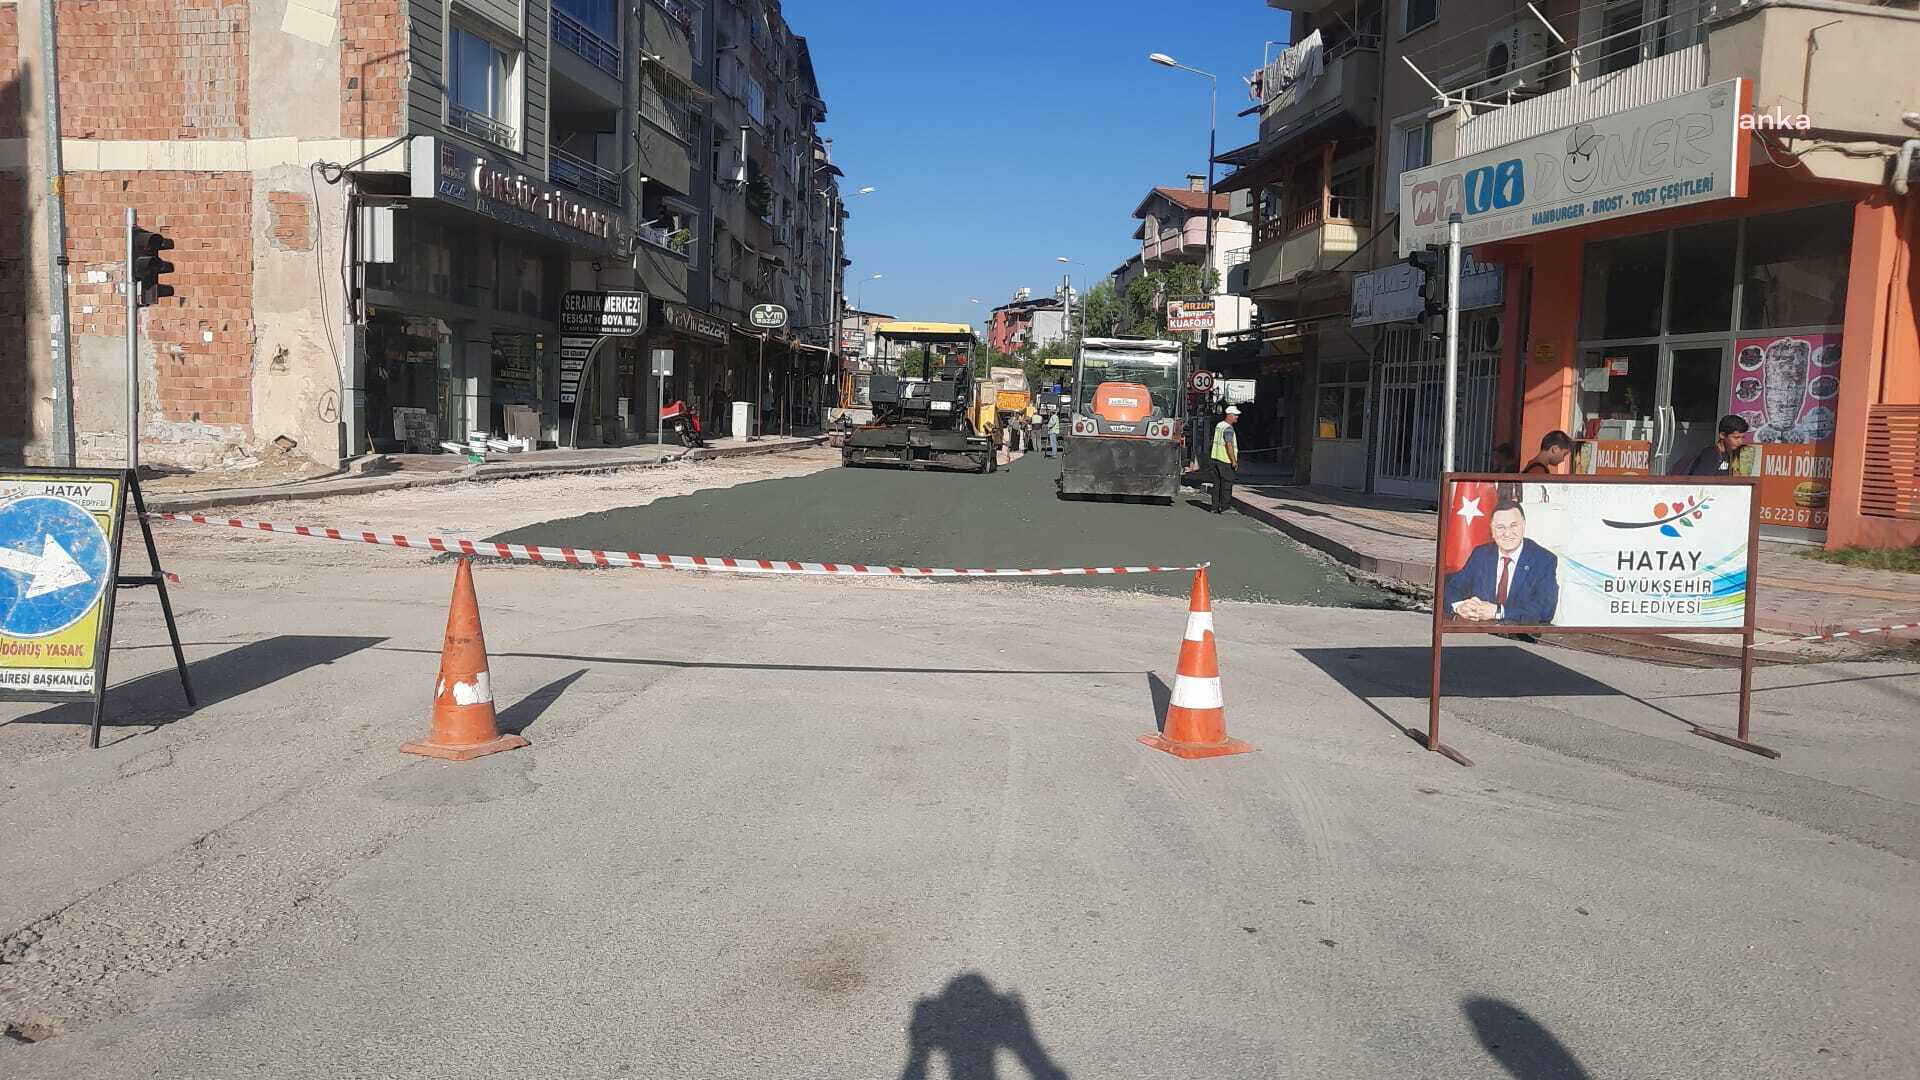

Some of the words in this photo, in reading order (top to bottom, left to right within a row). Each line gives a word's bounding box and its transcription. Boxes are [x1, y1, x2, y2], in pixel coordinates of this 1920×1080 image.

[1531, 203, 1585, 226] HAMBURGER
[1592, 194, 1623, 215] BROST
[1632, 188, 1657, 206] TOST
[1660, 172, 1714, 205] ÇEŞİTLERİ
[604, 295, 640, 313] MERKEZİ
[602, 314, 623, 326] BOYA
[1195, 376, 1211, 387] 30
[1597, 445, 1618, 468] MALİ
[1620, 444, 1649, 469] DÖNER
[1765, 449, 1792, 477] MALİ
[1794, 450, 1833, 479] DÖNER
[45, 485, 92, 497] HATAY
[1760, 506, 1772, 519] 26
[1775, 507, 1795, 521] 223
[1797, 509, 1811, 522] 67
[1814, 511, 1829, 524] 67
[1617, 550, 1702, 571] HATAY
[1604, 577, 1712, 596] BÜYÜKŞEHİR
[1610, 598, 1701, 614] BELEDİYESİ
[2, 641, 41, 658] DÖNÜŞ
[46, 643, 84, 657] YASAK
[0, 671, 31, 686] AİRESİ
[33, 672, 94, 688] BAŞKANLIĞI
